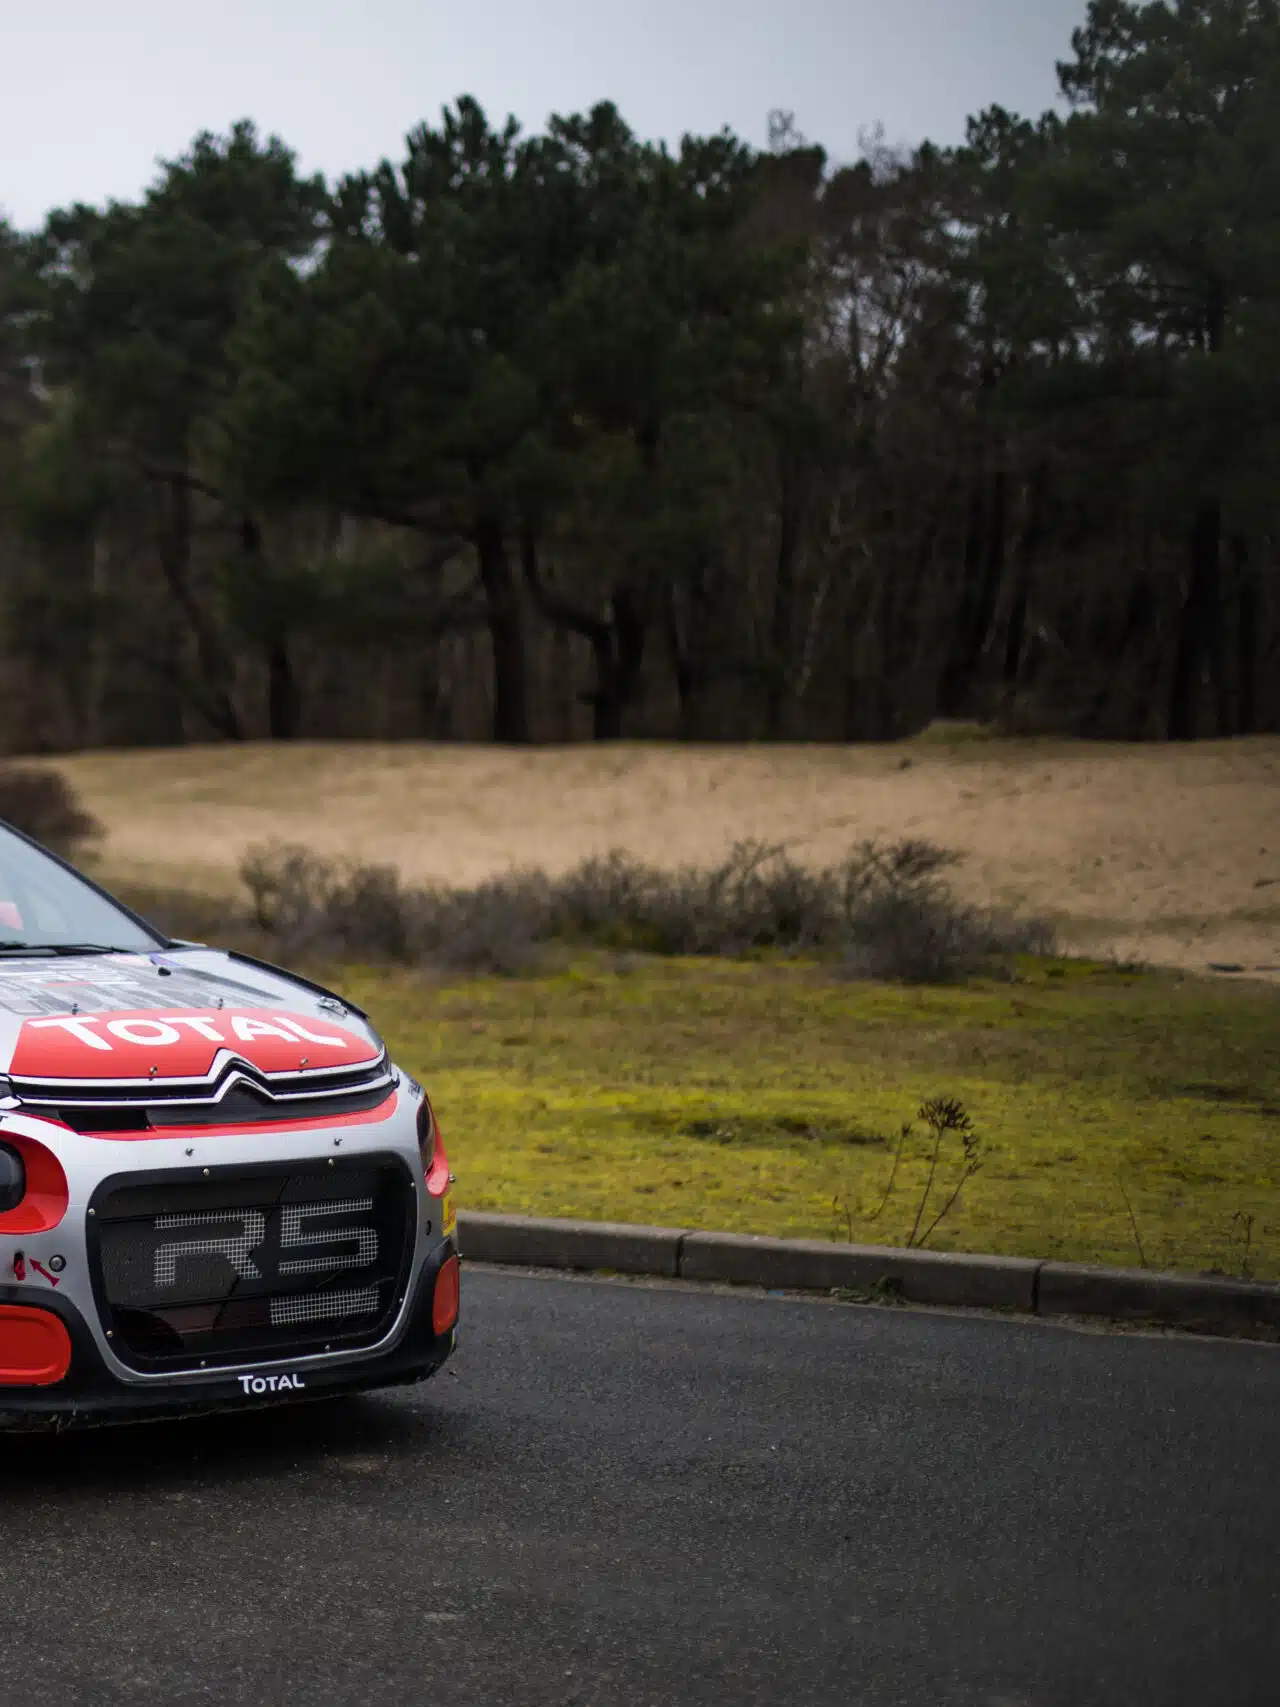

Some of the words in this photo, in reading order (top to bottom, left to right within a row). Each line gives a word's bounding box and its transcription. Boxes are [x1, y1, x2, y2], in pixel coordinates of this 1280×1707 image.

[28, 1015, 348, 1051] TOTAL
[153, 1198, 379, 1287] R5
[238, 1373, 305, 1394] TOTAL
